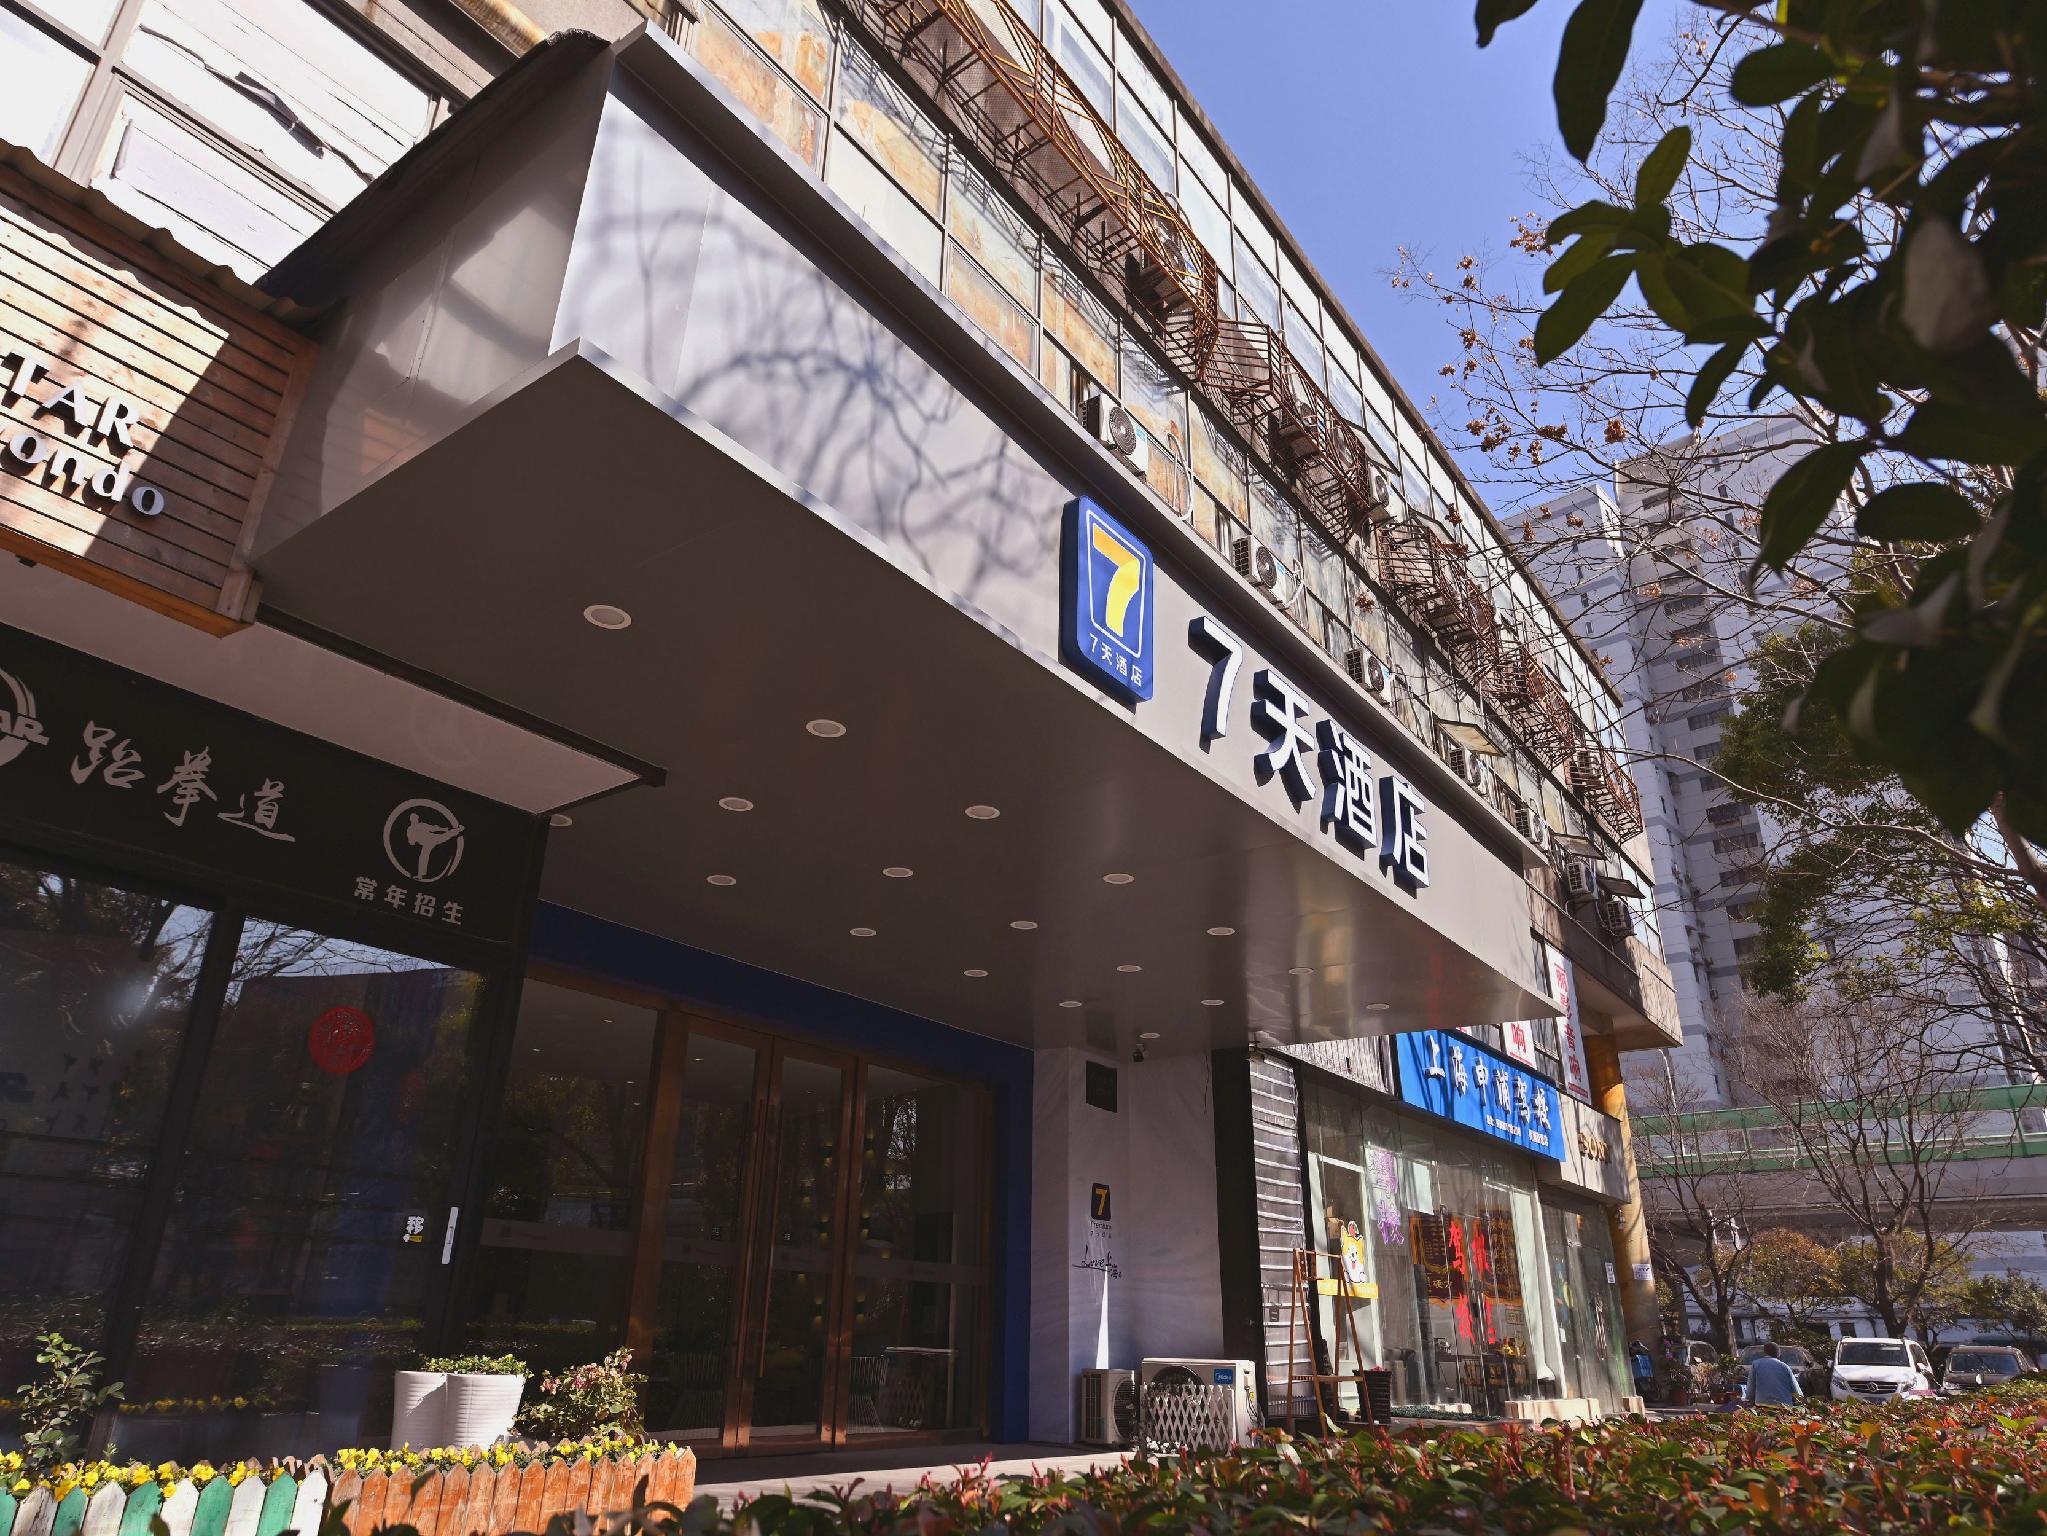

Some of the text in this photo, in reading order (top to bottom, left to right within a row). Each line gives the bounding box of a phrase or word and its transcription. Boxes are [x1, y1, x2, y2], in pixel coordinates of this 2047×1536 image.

[1092, 522, 1140, 638] 7
[1089, 632, 1142, 687] 7天酒店
[70, 720, 296, 842] 跆拳道
[1190, 616, 1430, 888] 7天酒店
[354, 876, 464, 925] 常年招生
[1095, 1187, 1108, 1216] 7
